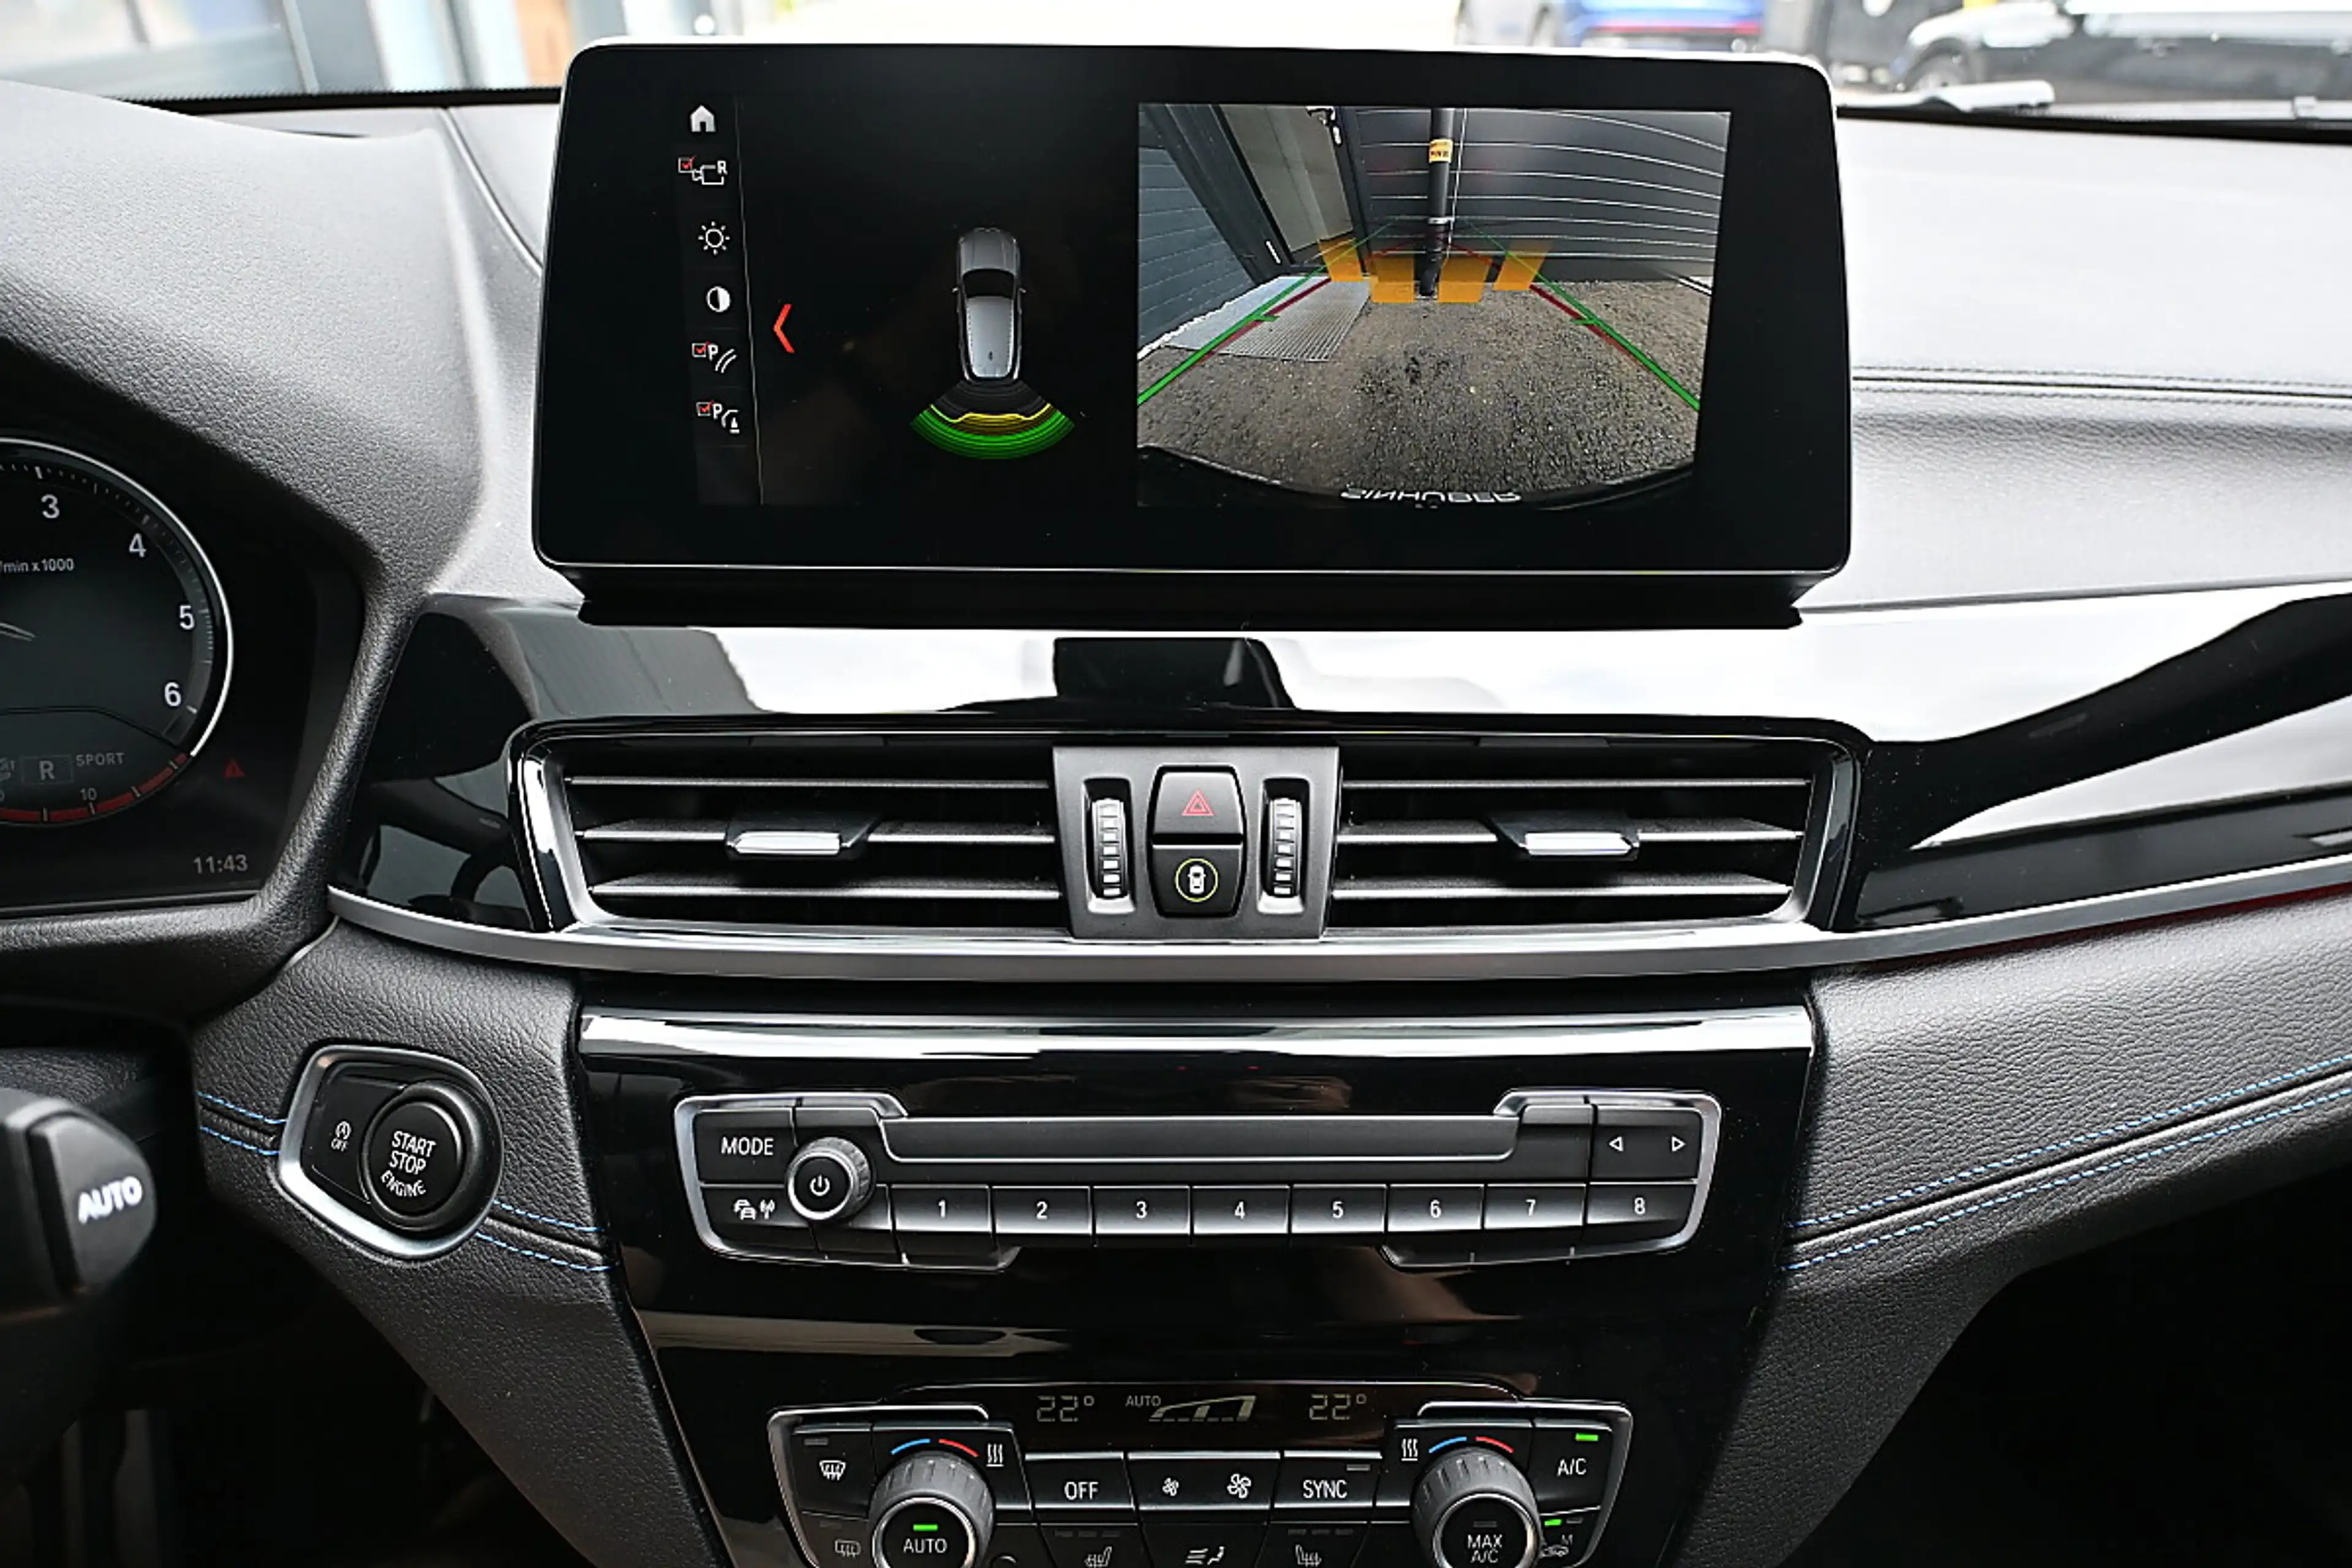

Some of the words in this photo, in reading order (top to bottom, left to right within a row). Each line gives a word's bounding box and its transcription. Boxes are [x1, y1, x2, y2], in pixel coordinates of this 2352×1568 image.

[40, 494, 60, 519] 3
[128, 532, 147, 558] 4
[179, 604, 195, 630] 5
[164, 681, 182, 707] 6
[76, 752, 125, 767] SPORT
[38, 760, 55, 781] R
[79, 787, 97, 801] 10
[194, 854, 248, 874] 11:43
[391, 1131, 436, 1158] START
[720, 1136, 774, 1156] MODE
[388, 1150, 426, 1175] STOP
[380, 1169, 427, 1197] ENGINE
[78, 1175, 143, 1224] AUTO
[937, 1200, 946, 1218] 1
[1430, 1199, 1442, 1218] 6
[1526, 1199, 1536, 1216] 7
[1634, 1197, 1646, 1215] 8
[1036, 1201, 1048, 1219] 2
[1136, 1201, 1148, 1219] 3
[1234, 1201, 1246, 1219] 4
[1332, 1200, 1344, 1219] 5
[1125, 1395, 1161, 1407] AUTO
[1556, 1458, 1587, 1477] A/C
[1064, 1481, 1099, 1501] OFF
[1302, 1479, 1348, 1499] SYNC
[903, 1538, 948, 1555] AUTO
[1468, 1534, 1503, 1549] MAX
[1470, 1548, 1499, 1563] A/C
